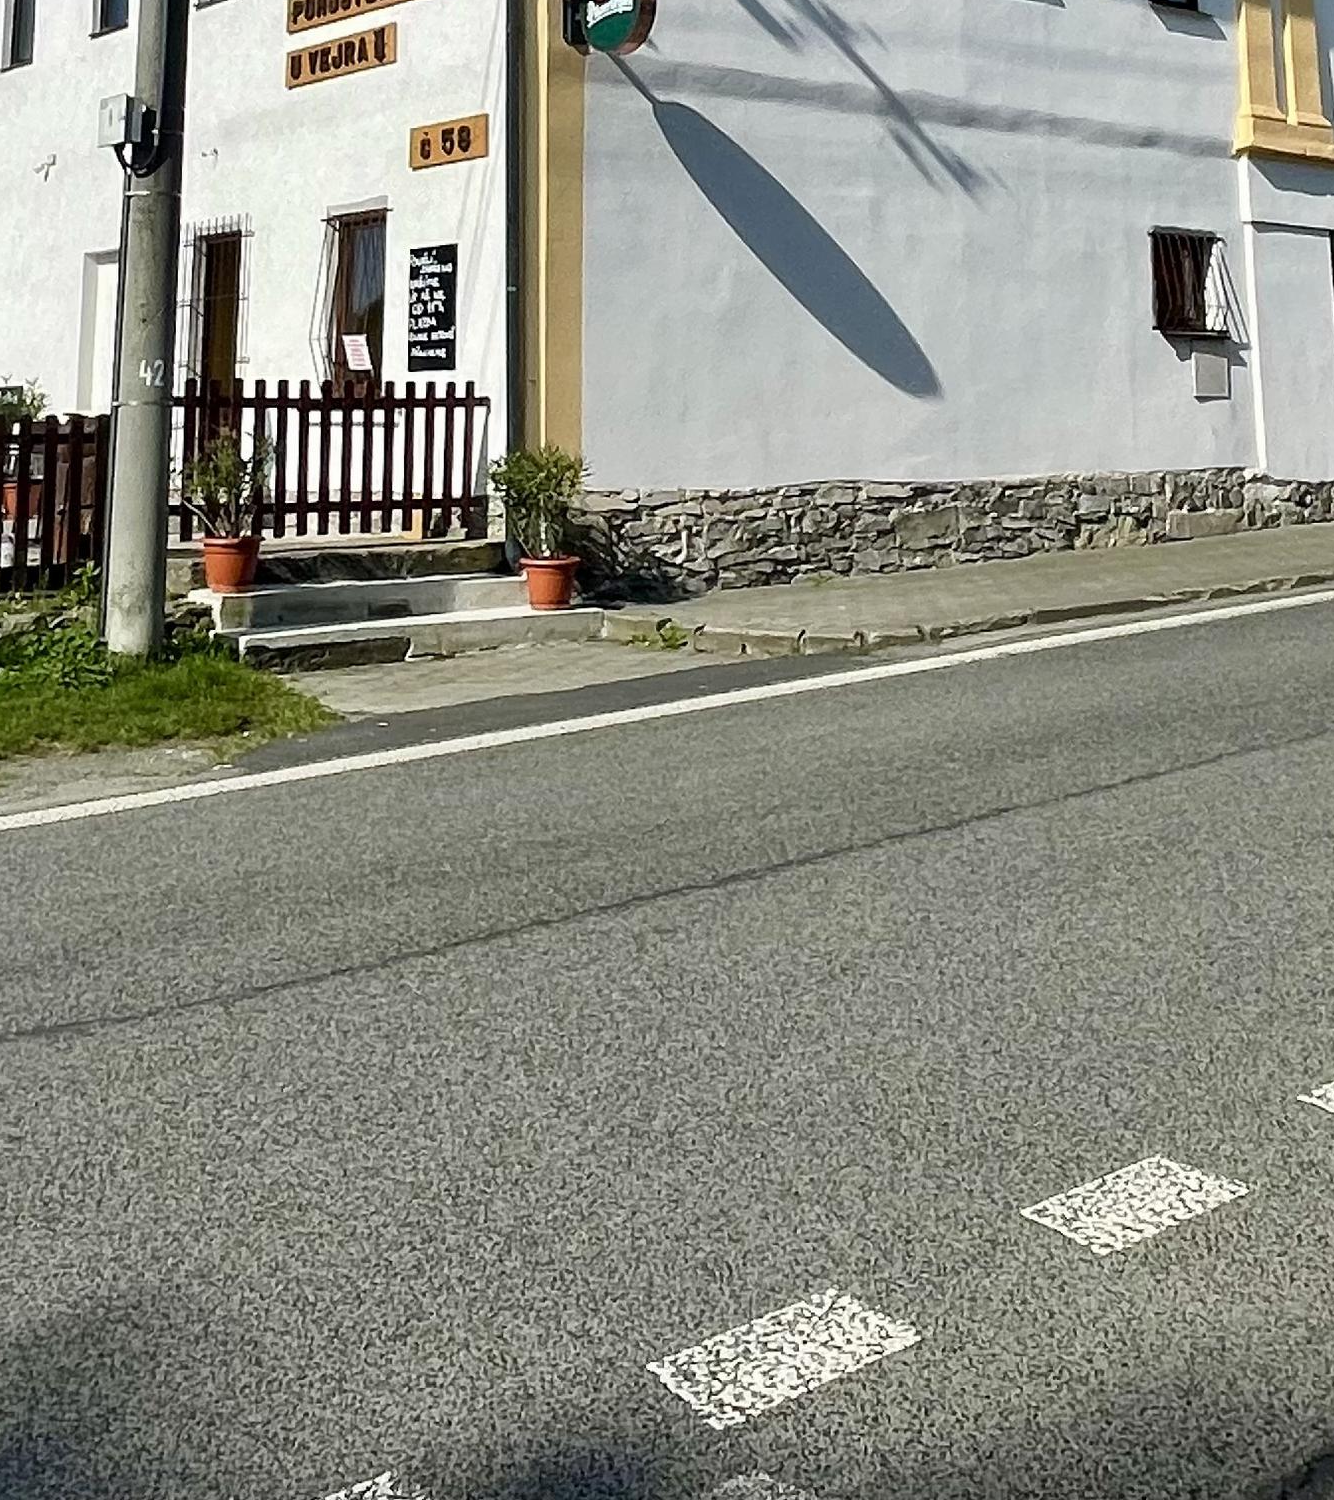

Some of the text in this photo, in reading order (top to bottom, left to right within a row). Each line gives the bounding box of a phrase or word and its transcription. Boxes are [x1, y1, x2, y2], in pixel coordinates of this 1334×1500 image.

[290, 37, 369, 81] U VEJRA
[139, 360, 165, 387] 42
